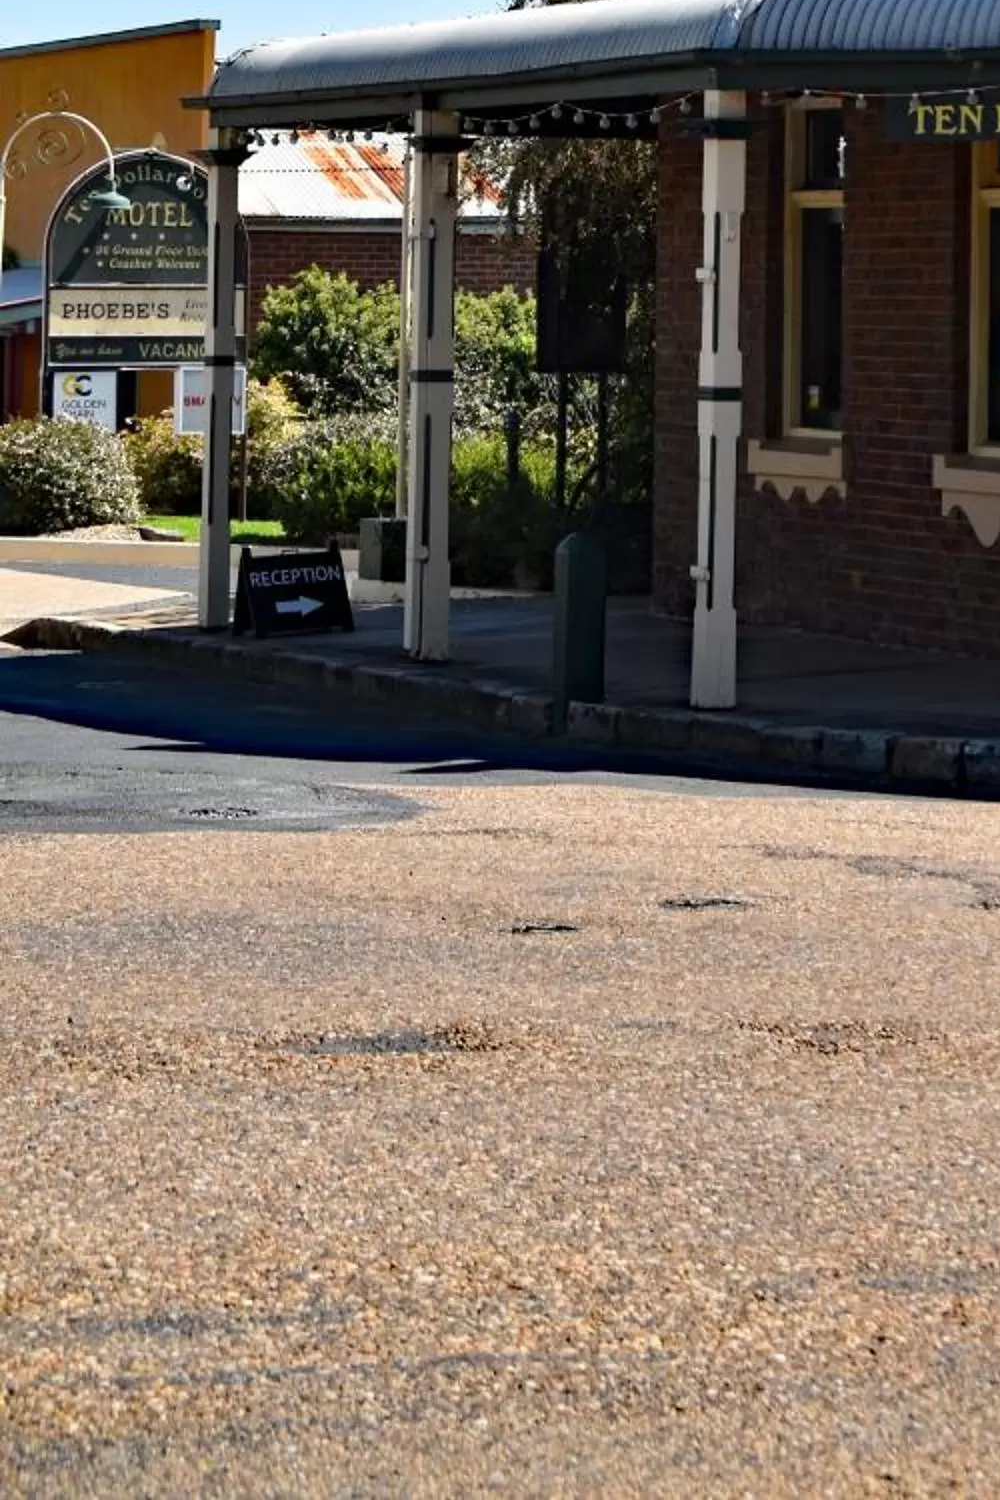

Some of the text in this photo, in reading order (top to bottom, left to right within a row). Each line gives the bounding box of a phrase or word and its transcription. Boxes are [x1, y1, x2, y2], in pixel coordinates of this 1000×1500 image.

[909, 103, 984, 134] TEN
[105, 201, 193, 227] MOTEL
[61, 303, 170, 319] PHOEBE'S
[61, 399, 107, 409] GOLDEN
[249, 565, 341, 588] RECEPTION
